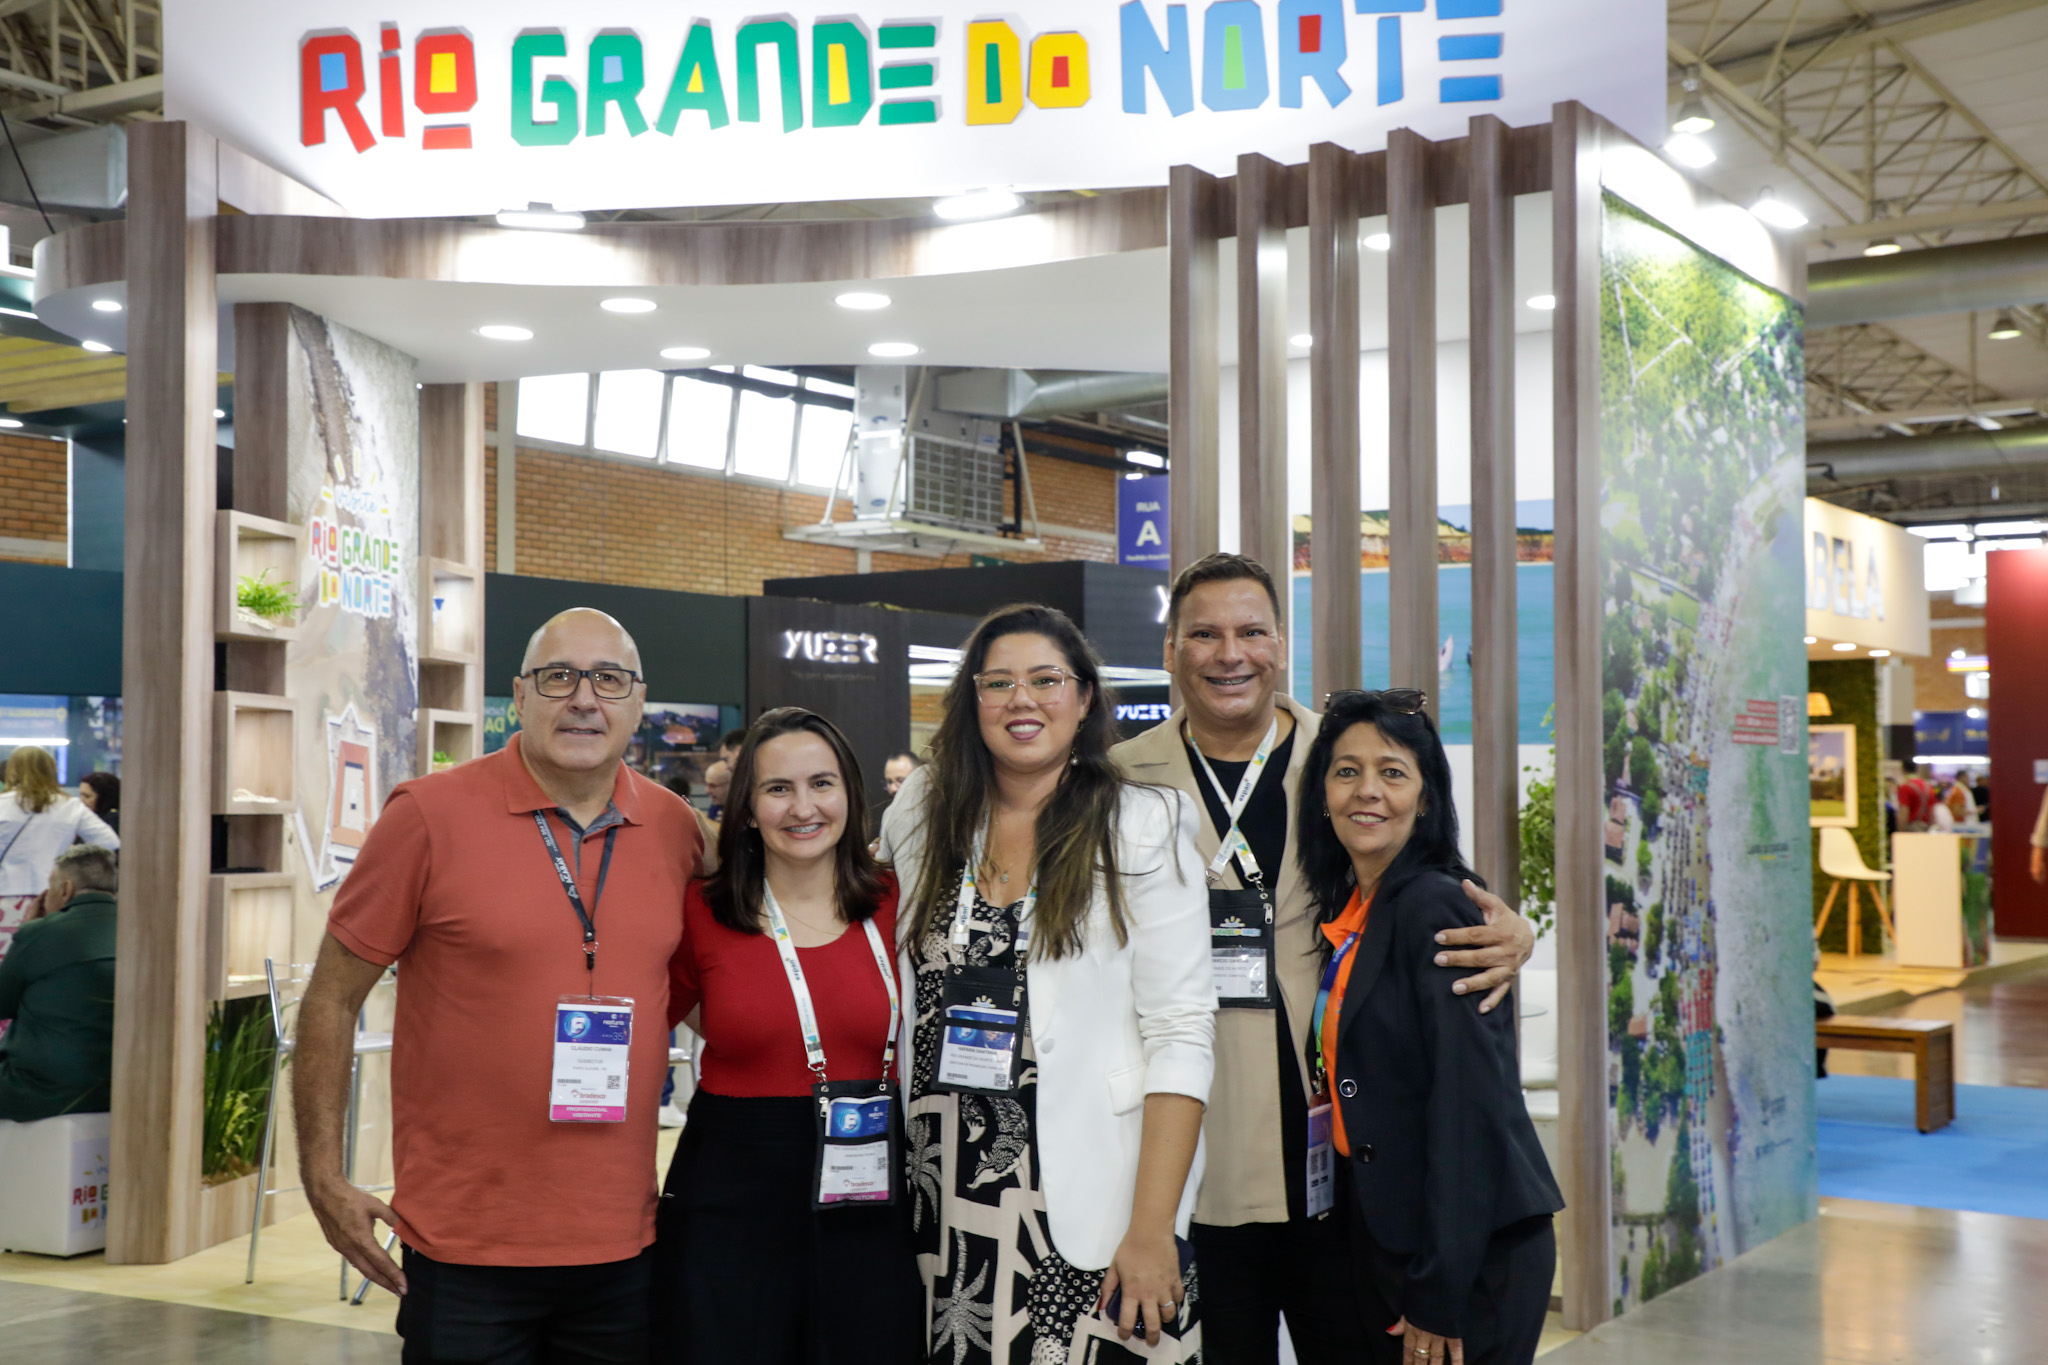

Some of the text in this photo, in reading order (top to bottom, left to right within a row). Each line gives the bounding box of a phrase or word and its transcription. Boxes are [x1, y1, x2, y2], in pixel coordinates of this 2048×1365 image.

[511, 18, 939, 147] GRANDE
[1120, 0, 1503, 117] NORTE
[1135, 501, 1161, 513] RUA
[342, 530, 399, 574] GRANDE
[1135, 519, 1162, 547] A
[342, 573, 391, 613] NORTE
[1804, 531, 1885, 621] BELA
